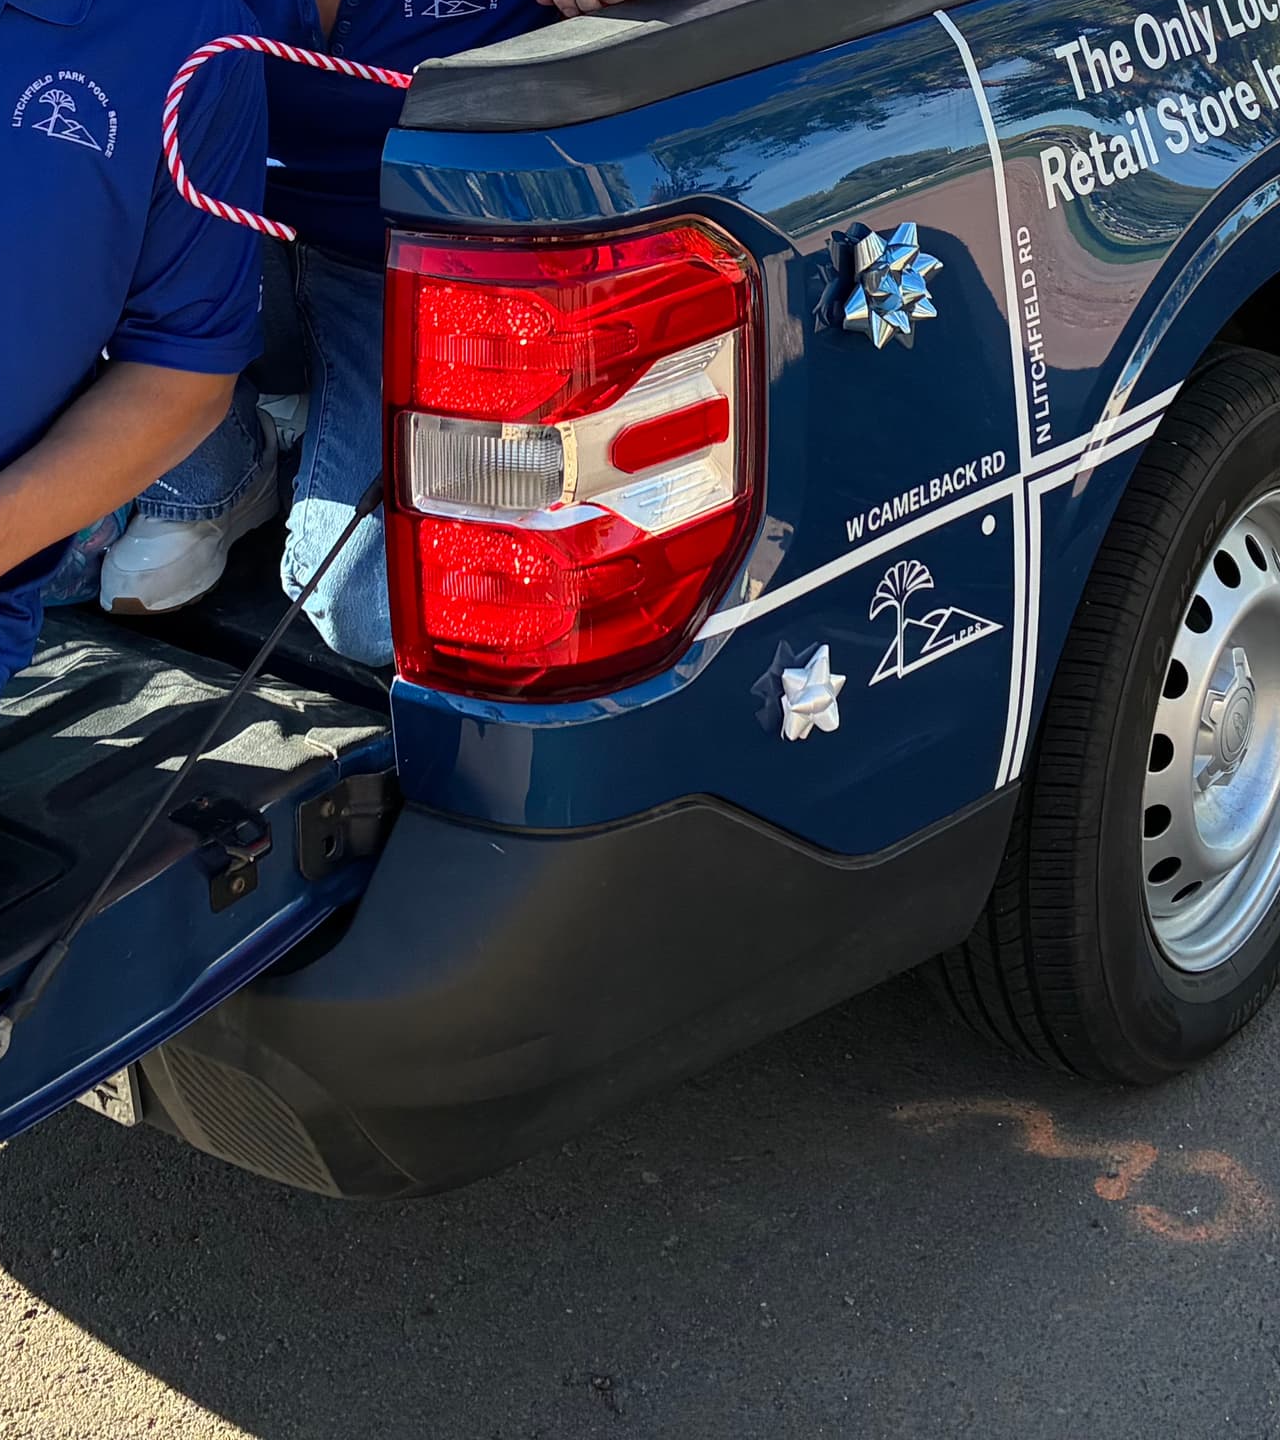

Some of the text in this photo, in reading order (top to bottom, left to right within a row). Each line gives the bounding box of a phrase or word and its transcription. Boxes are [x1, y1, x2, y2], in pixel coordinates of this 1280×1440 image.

[11, 70, 118, 159] LITCHFIELD PARK POOL SERVICE
[1054, 35, 1134, 101] The
[1039, 105, 1159, 210] Retail
[1156, 68, 1261, 154] Store
[1017, 226, 1052, 445] N LITCHFIELD RD
[846, 450, 1007, 543] W CAMELBACK RD
